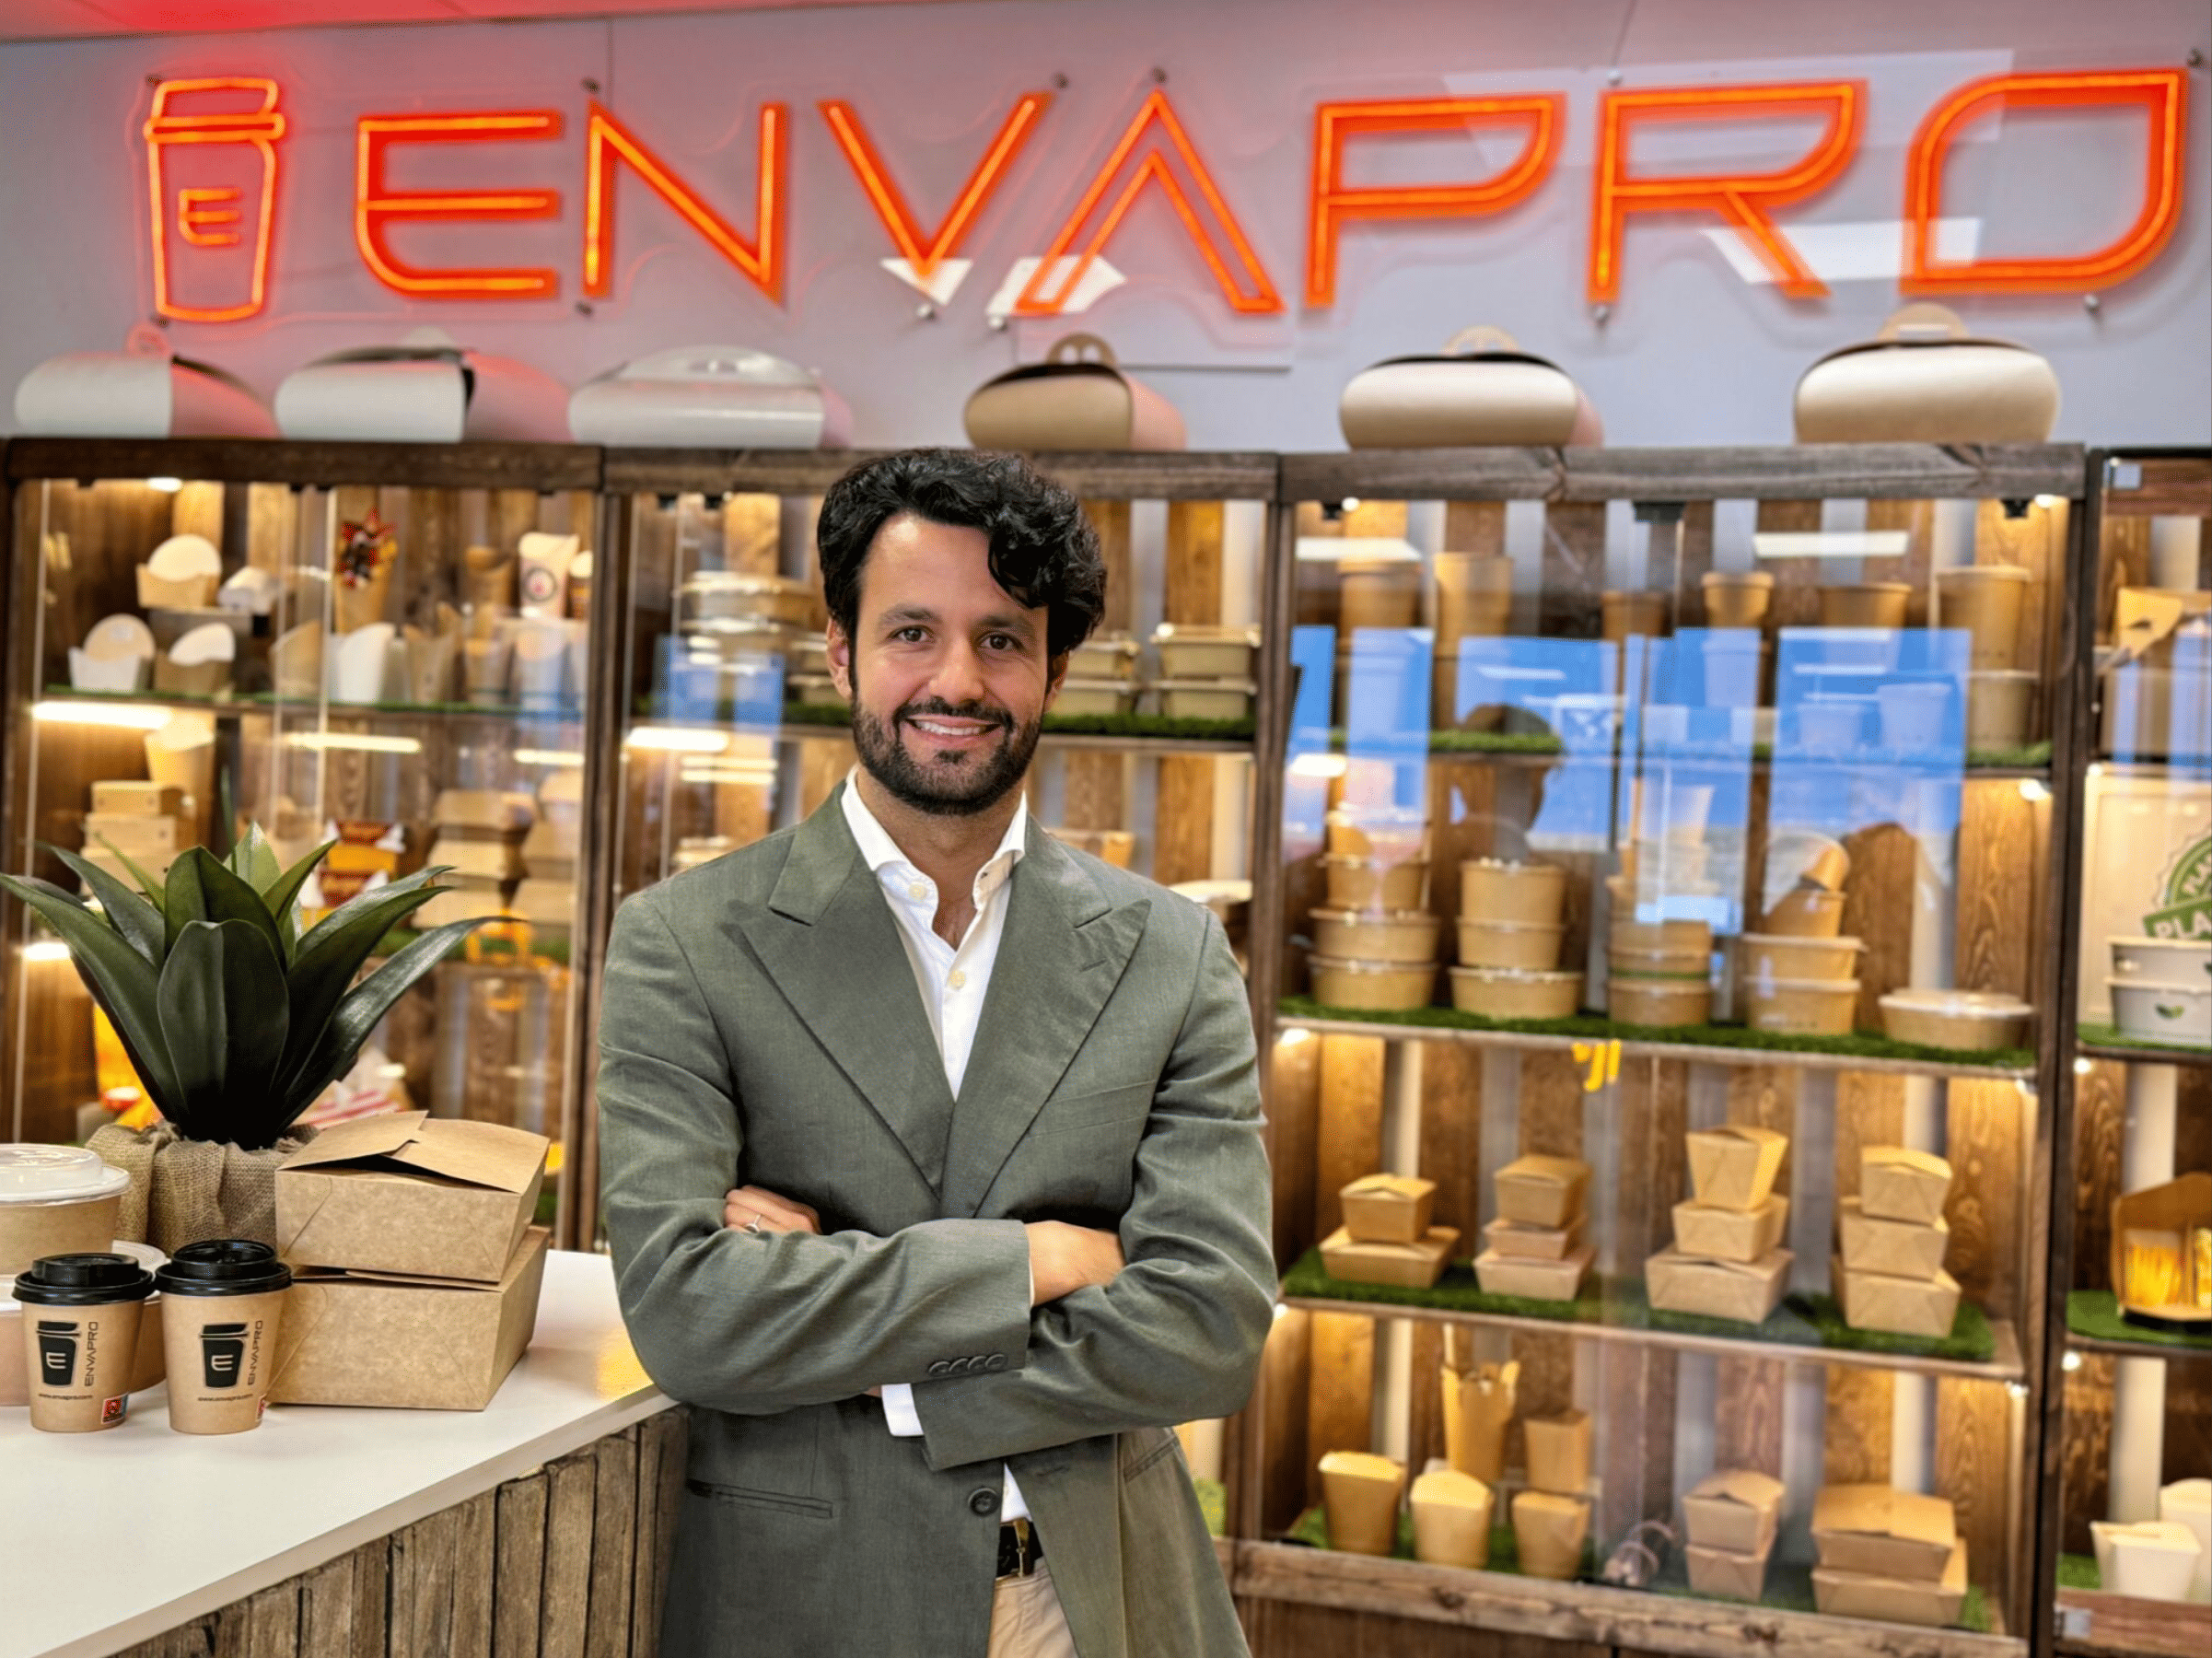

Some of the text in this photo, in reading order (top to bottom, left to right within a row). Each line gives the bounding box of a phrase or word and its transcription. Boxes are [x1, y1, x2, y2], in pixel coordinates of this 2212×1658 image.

[355, 67, 2189, 313] ENVAPRO
[84, 1321, 99, 1387] ENVAPRO
[247, 1320, 263, 1385] ENVAPRO
